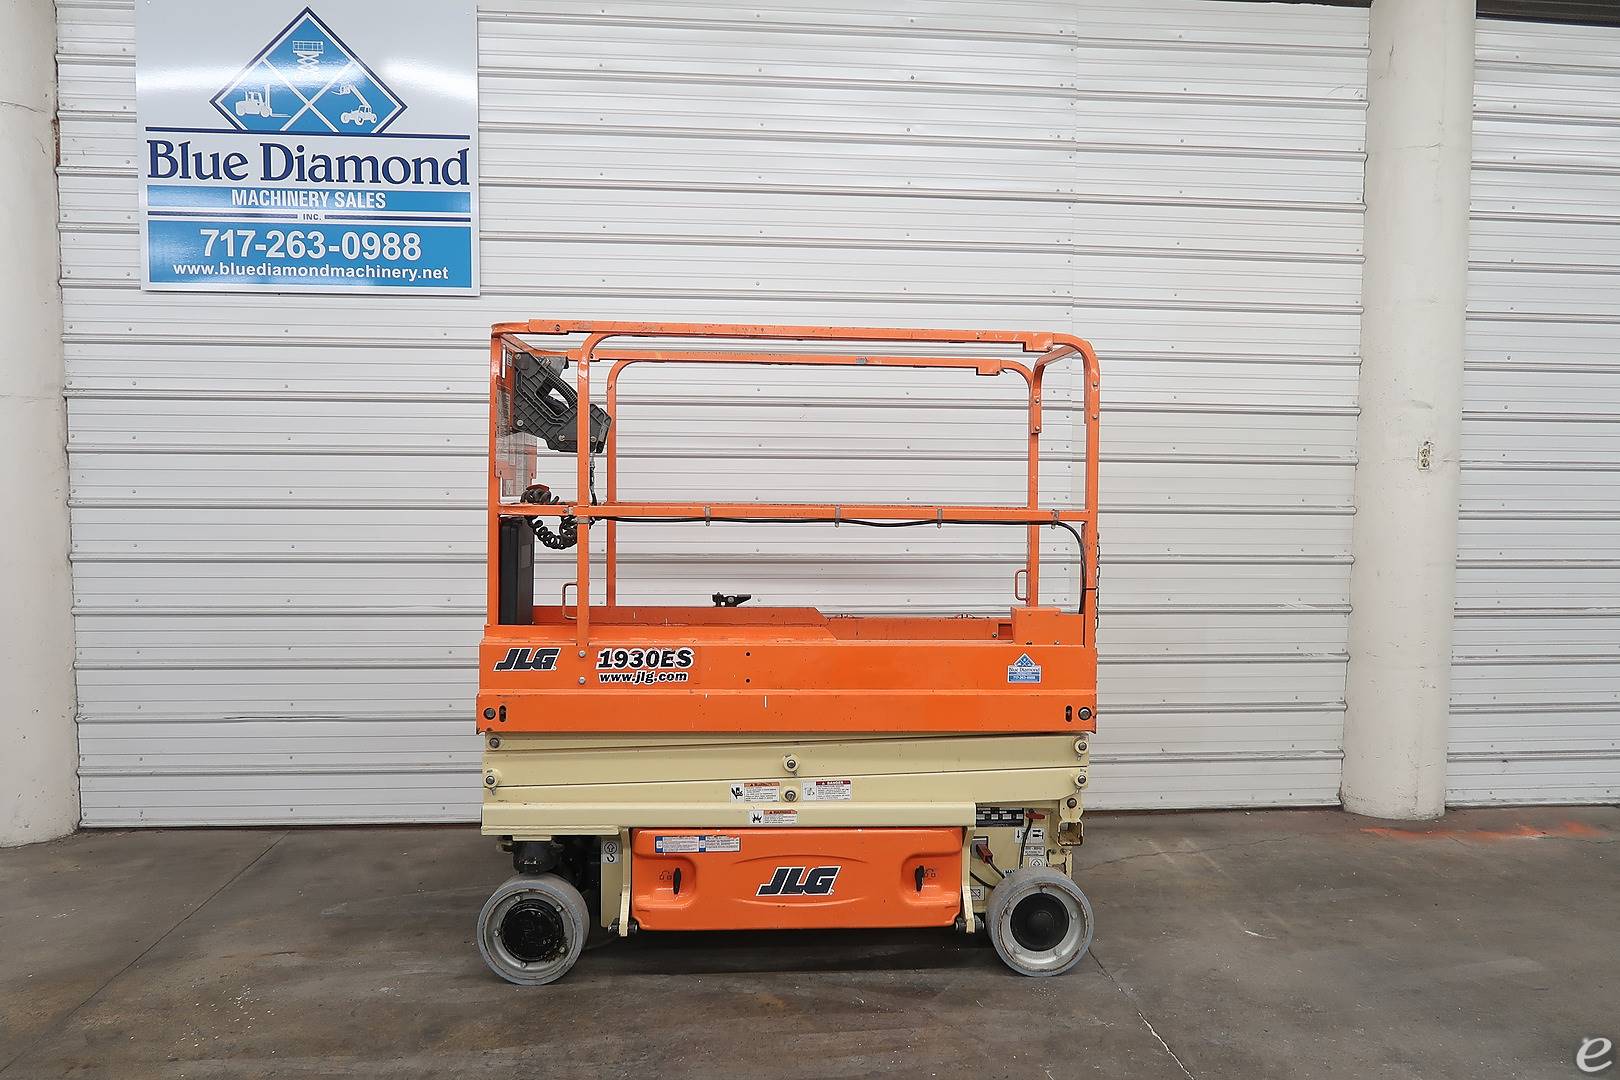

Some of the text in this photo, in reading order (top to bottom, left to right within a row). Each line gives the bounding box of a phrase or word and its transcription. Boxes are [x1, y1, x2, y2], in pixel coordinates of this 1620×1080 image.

[146, 139, 470, 186] Blue Diamond
[231, 189, 386, 209] MACHINERY SALES
[302, 212, 322, 222] INC.
[199, 228, 422, 261] 717-263-0988
[173, 261, 449, 282] www.bluediamondmachinery.net
[494, 647, 695, 671] JLG 1930ES
[598, 670, 689, 685] www.jlg.com
[756, 866, 841, 896] JLG
